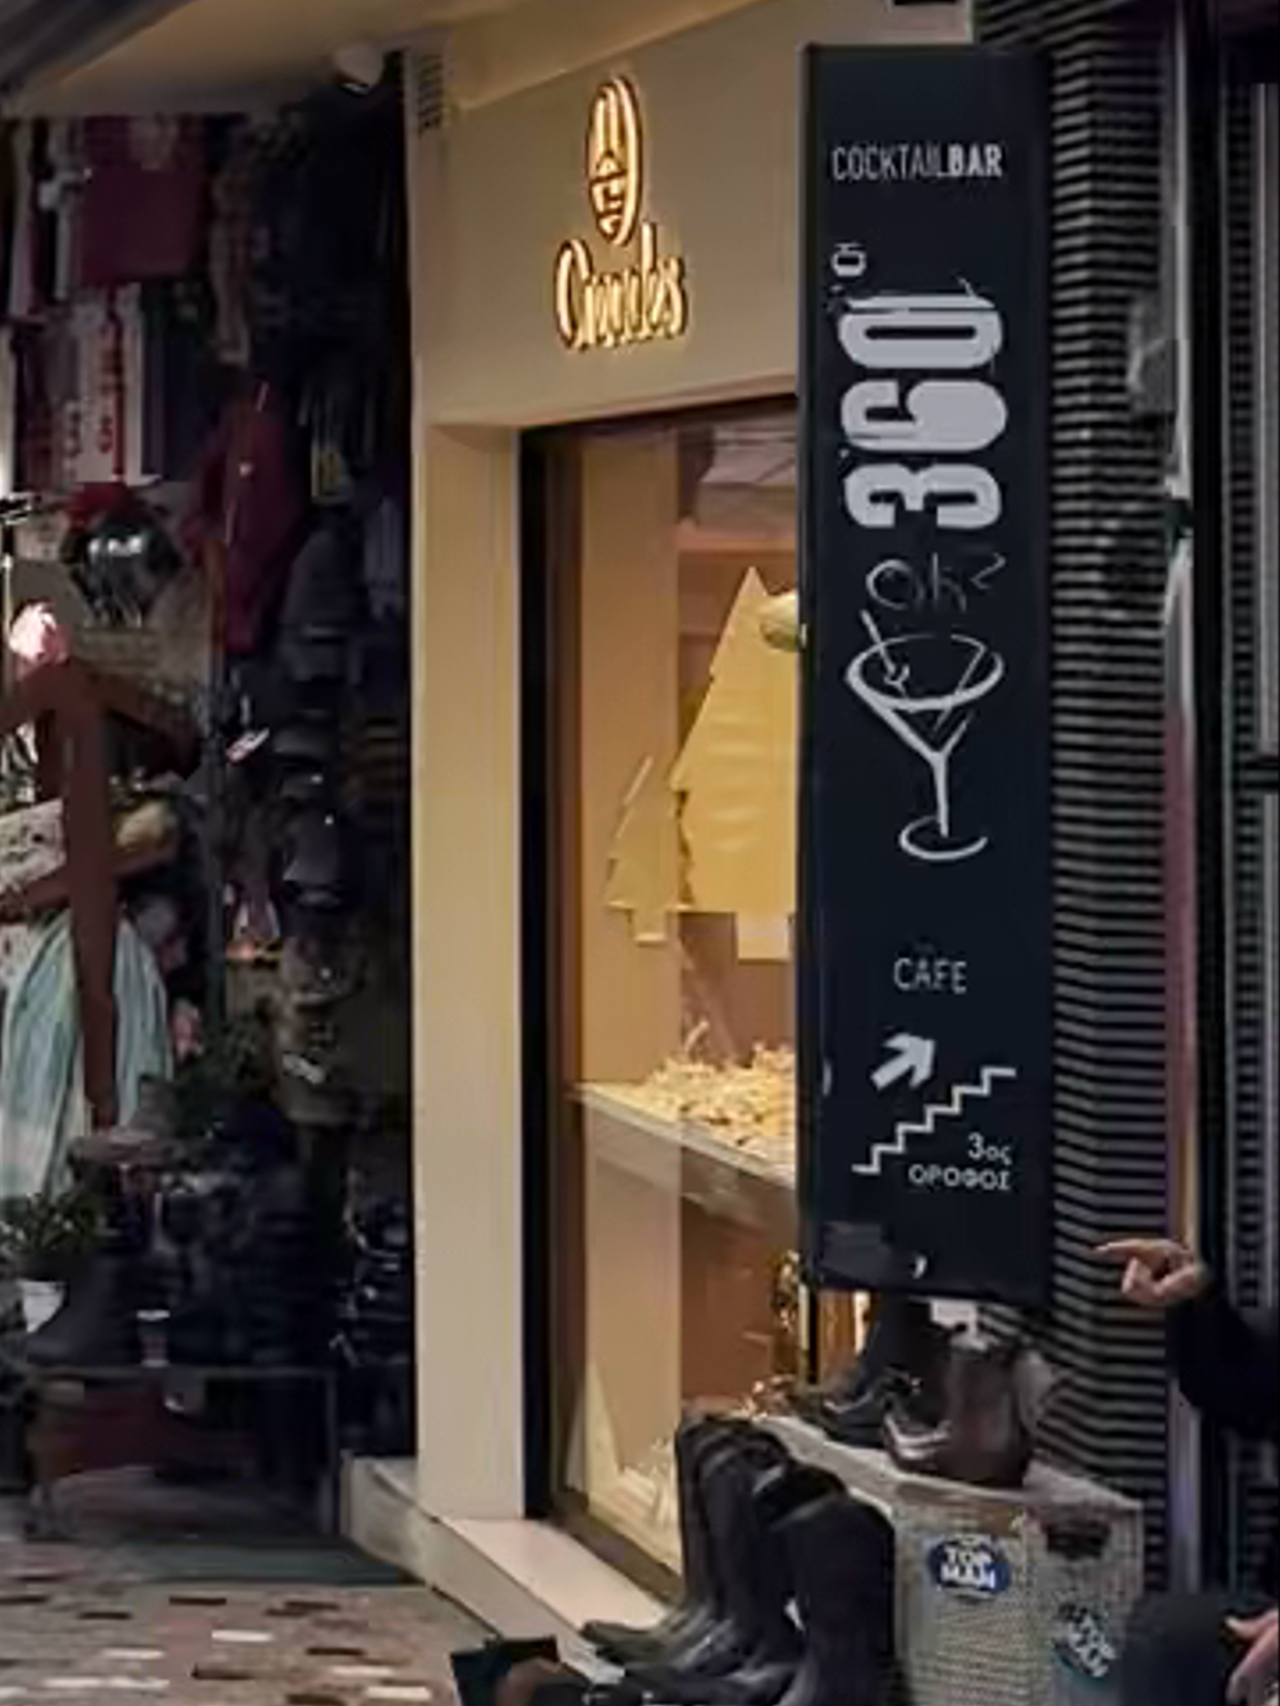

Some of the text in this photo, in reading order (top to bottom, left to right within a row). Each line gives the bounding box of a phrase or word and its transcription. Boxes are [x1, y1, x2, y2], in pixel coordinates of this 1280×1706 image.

[893, 956, 968, 995] CAFE
[943, 1546, 992, 1567] TOP
[939, 1563, 997, 1590] MAN
